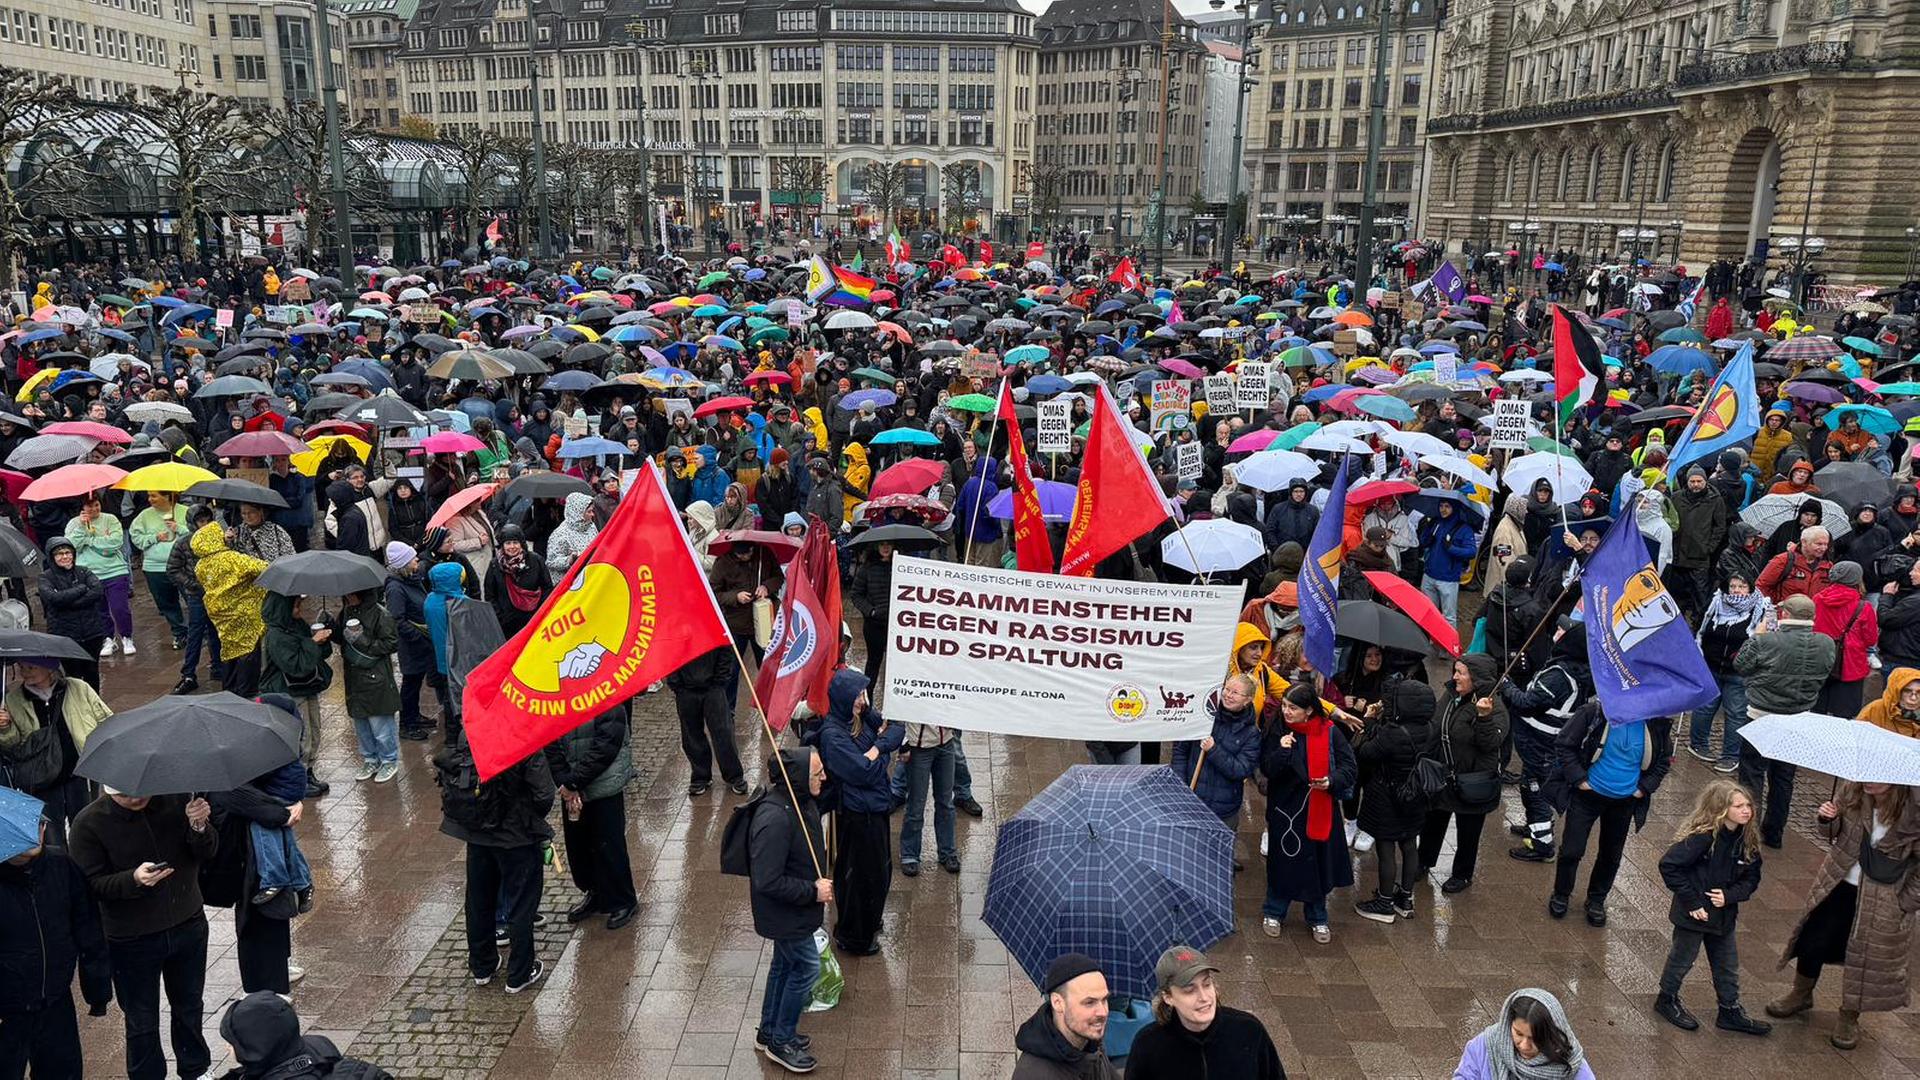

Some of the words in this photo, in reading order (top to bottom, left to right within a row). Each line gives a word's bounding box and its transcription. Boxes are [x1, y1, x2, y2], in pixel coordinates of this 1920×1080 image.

[1244, 366, 1265, 376] OMAS
[1208, 377, 1228, 387] OMAS
[1240, 378, 1266, 389] GEGEN
[1209, 391, 1233, 401] GEGEN
[1238, 391, 1268, 401] RECHTS
[1043, 405, 1065, 416] OMAS
[1210, 403, 1237, 413] RECHTS
[1501, 403, 1525, 415] OMAS
[1041, 419, 1067, 430] GEGEN
[1496, 417, 1526, 428] GEGEN
[1039, 433, 1069, 444] RECHTS
[1493, 429, 1527, 441] RECHTS
[897, 565, 940, 577] GEGEN
[945, 570, 1032, 587] RASSISTISCHE
[1036, 579, 1086, 591] GEWALT
[1089, 585, 1101, 593] IN
[1105, 586, 1168, 597] UNSEREM
[1171, 589, 1221, 599] VIERTEL
[897, 585, 1192, 623] ZUSAMMENSTEHEN
[897, 610, 998, 635] GEGEN
[1008, 622, 1184, 648] RASSISMUS
[896, 635, 959, 656] UND
[968, 642, 1123, 670] SPALTUNG
[893, 687, 956, 700] @ijv_altona
[910, 679, 1017, 696] STADTTEILGRUPPE
[1021, 690, 1066, 700] ALTONA
